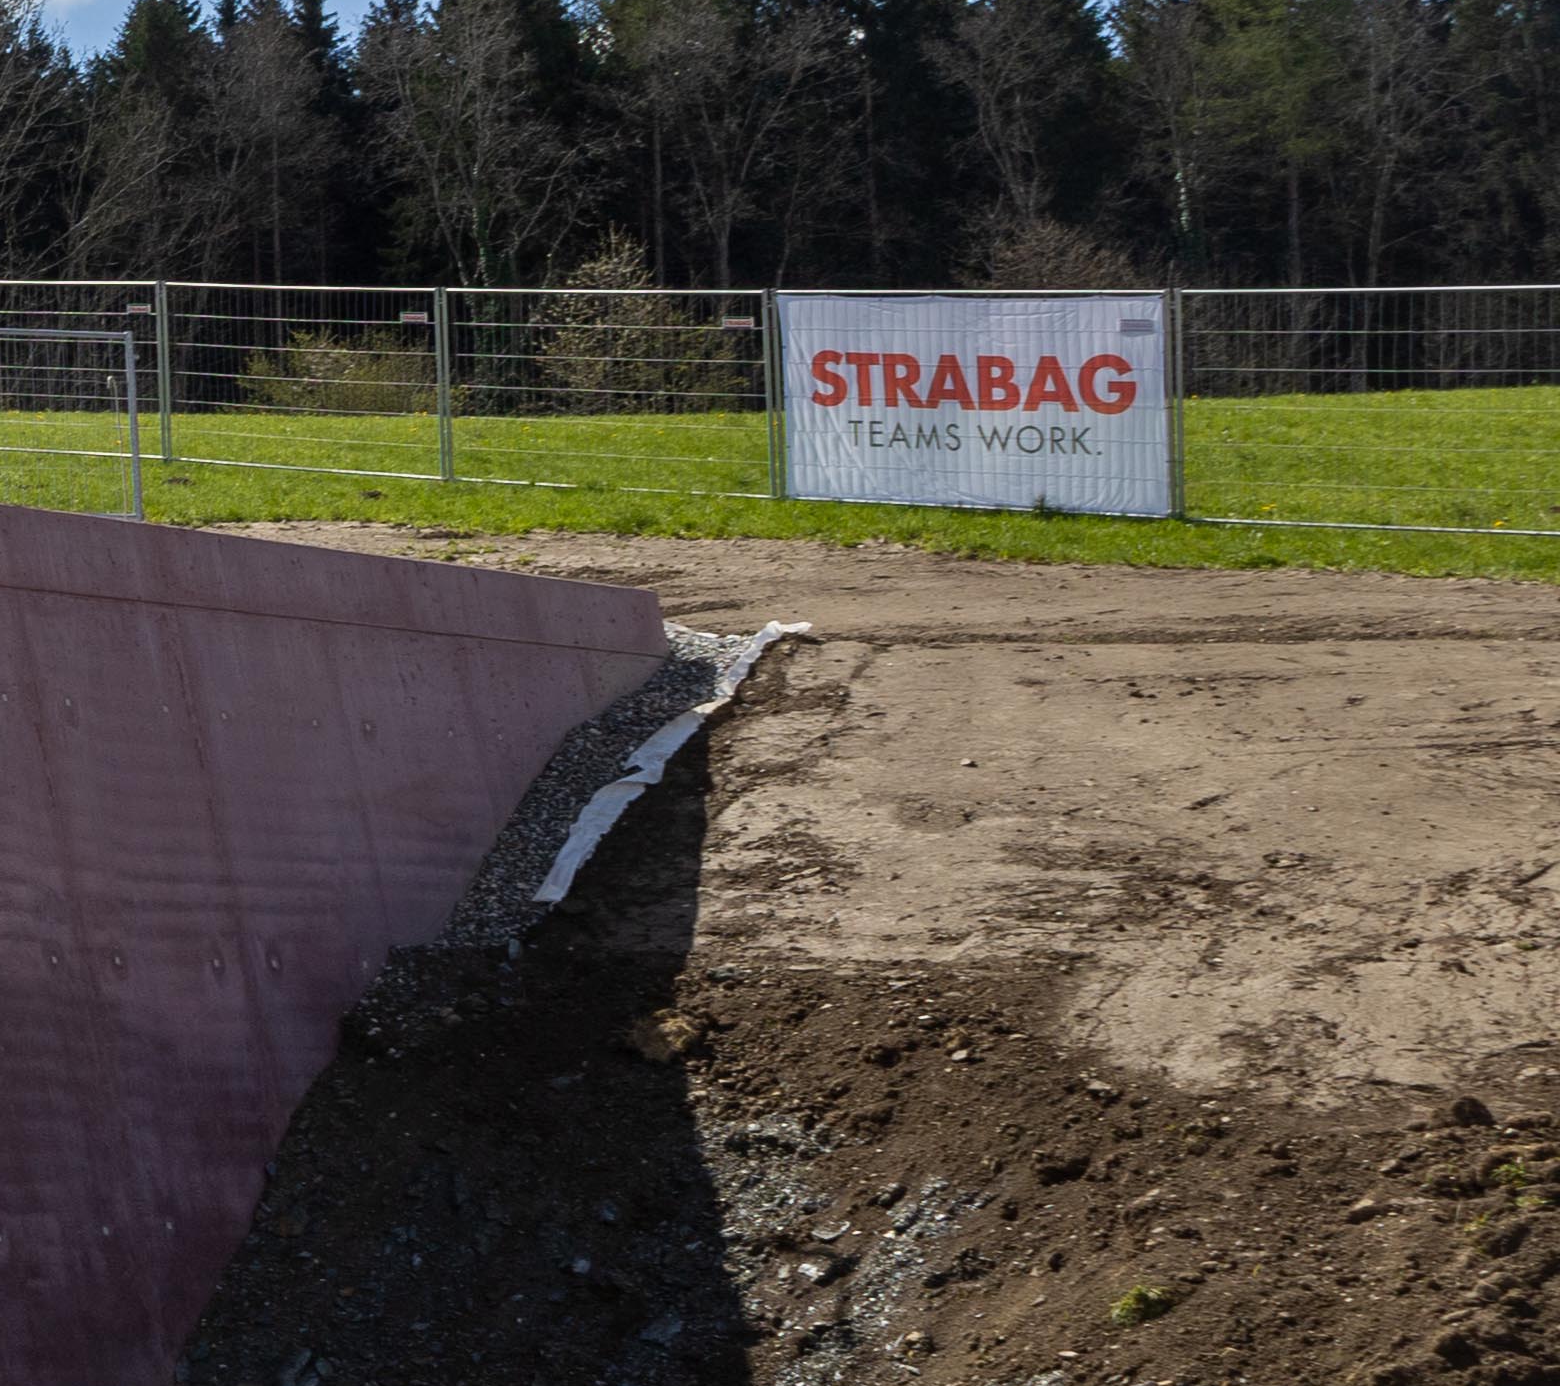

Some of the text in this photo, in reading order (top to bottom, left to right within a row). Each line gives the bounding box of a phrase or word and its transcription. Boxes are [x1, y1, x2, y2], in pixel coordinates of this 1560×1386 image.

[812, 350, 1137, 415] STRABAG
[847, 419, 1103, 456] TEAMS WORK.
